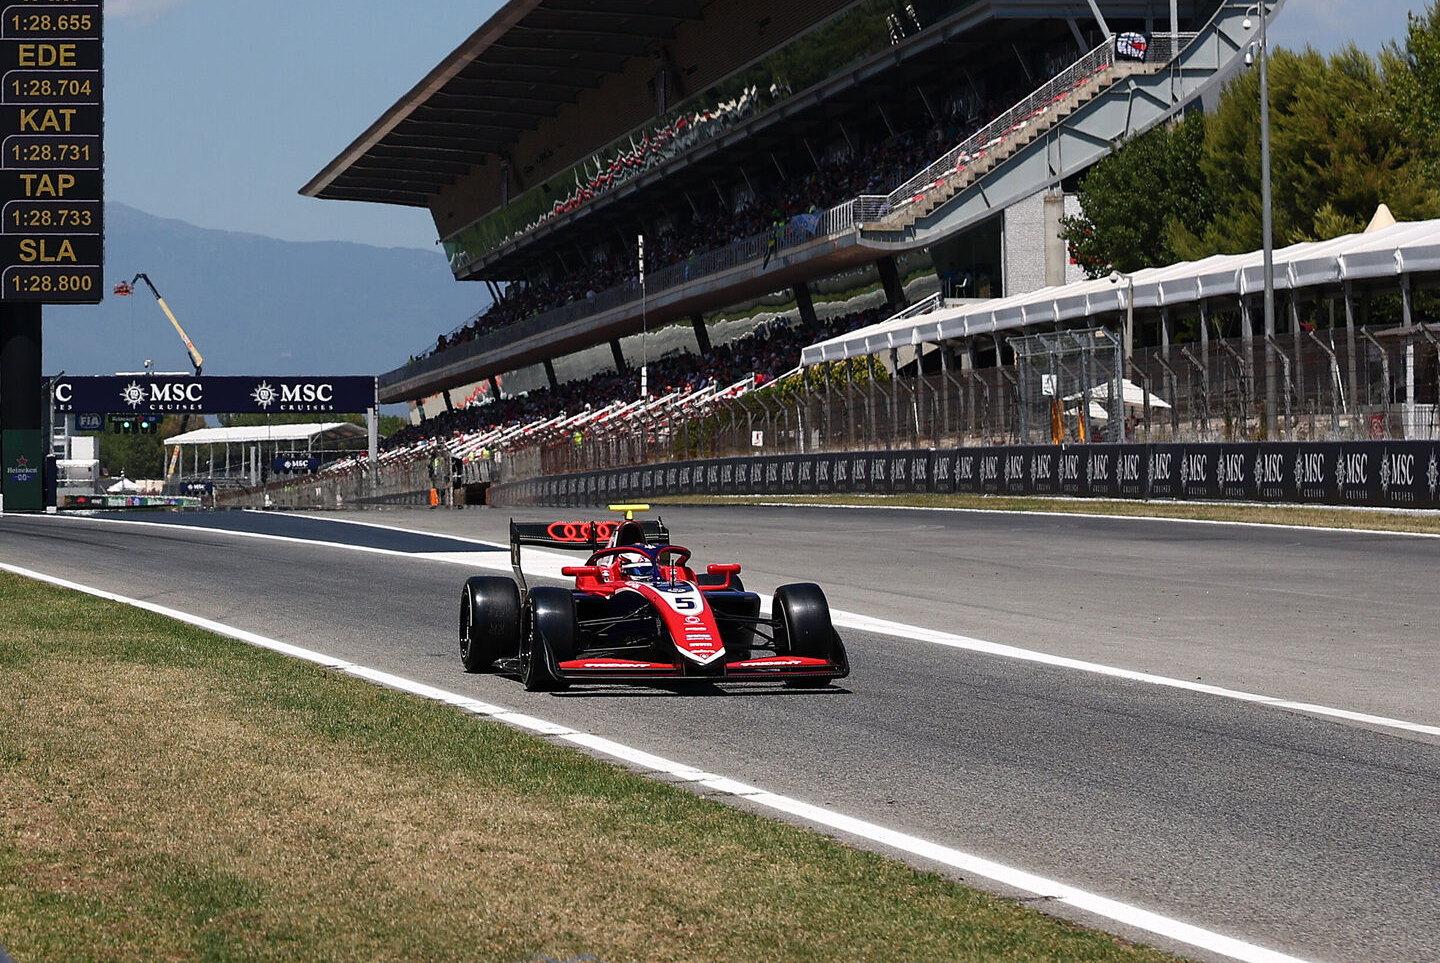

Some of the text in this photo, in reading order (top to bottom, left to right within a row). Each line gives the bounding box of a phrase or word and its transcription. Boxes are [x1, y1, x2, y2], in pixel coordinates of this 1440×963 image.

[12, 14, 92, 31] 1:28.655
[18, 44, 77, 67] EDE
[12, 79, 92, 96] 1:28.704
[20, 109, 77, 132] KAT
[12, 144, 90, 161] 1:28.731
[19, 174, 75, 197] TAP
[12, 210, 92, 226] 1:28.733
[19, 239, 77, 262] SLA
[12, 275, 92, 292] 1:28.800
[149, 383, 203, 402] MSC
[280, 384, 333, 402] MSC
[80, 416, 99, 425] FIA
[1037, 454, 1051, 479] MSC
[1064, 454, 1079, 480] MSC
[1093, 454, 1108, 480] MSC
[1123, 454, 1140, 480] MSC
[1154, 453, 1172, 480] MSC
[1189, 454, 1208, 482] MSC
[1226, 453, 1245, 482] MSC
[1264, 453, 1284, 483] MSC
[1304, 453, 1325, 483] MSC
[1346, 453, 1368, 484] MSC
[1391, 453, 1415, 485] MSC
[674, 597, 696, 610] 5
